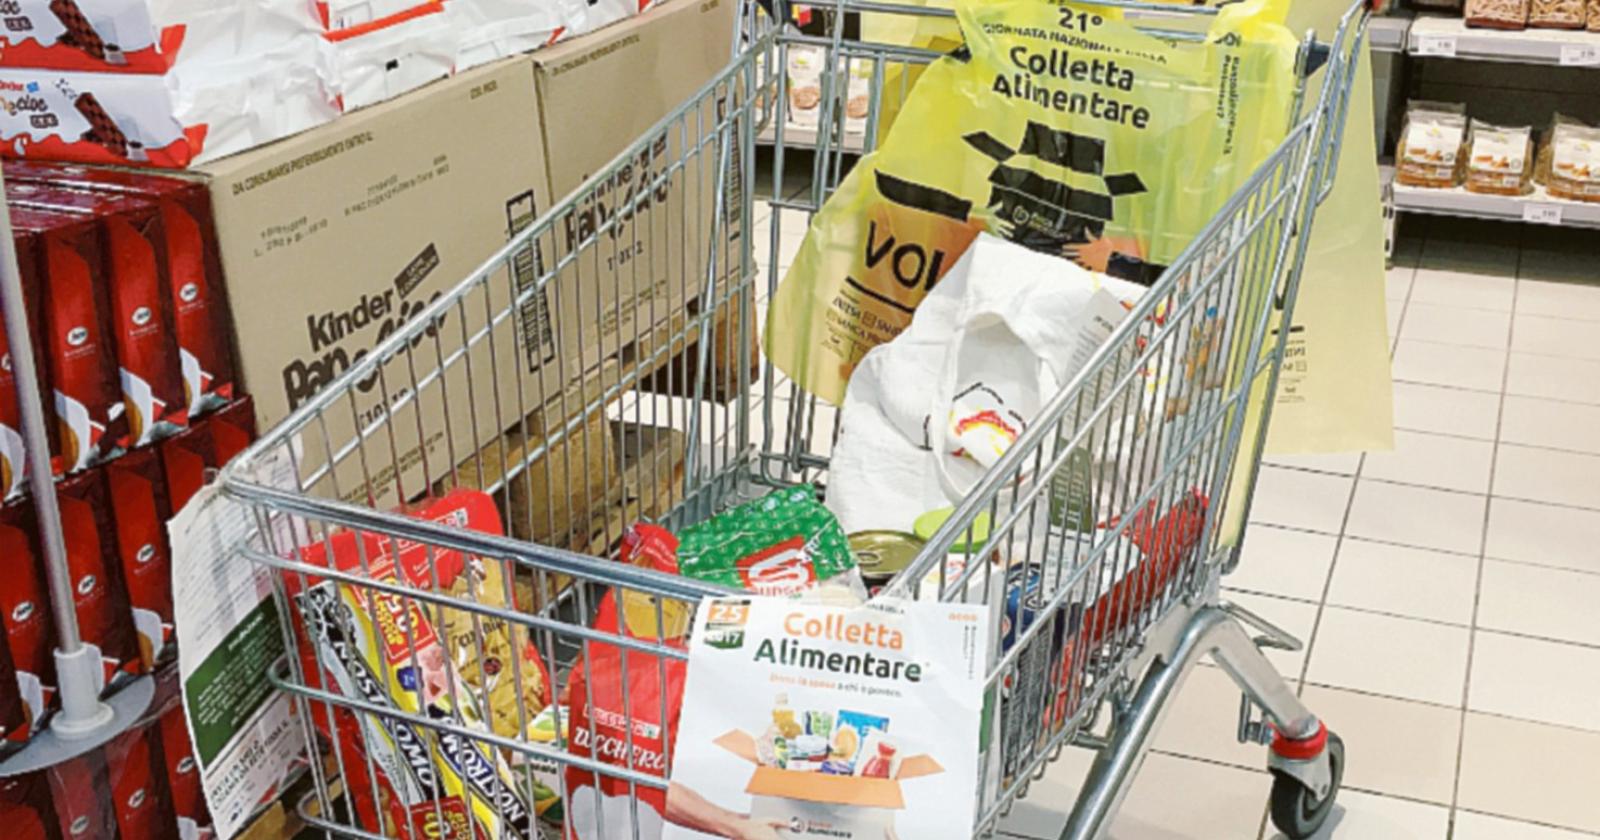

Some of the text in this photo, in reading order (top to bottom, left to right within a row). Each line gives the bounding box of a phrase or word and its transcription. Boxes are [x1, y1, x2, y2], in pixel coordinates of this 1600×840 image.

[1009, 46, 1136, 92] Colletta
[992, 73, 1152, 130] Alimentare
[307, 287, 394, 354] Kinder
[783, 611, 905, 650] Colletta
[753, 637, 923, 683] Alimentare
